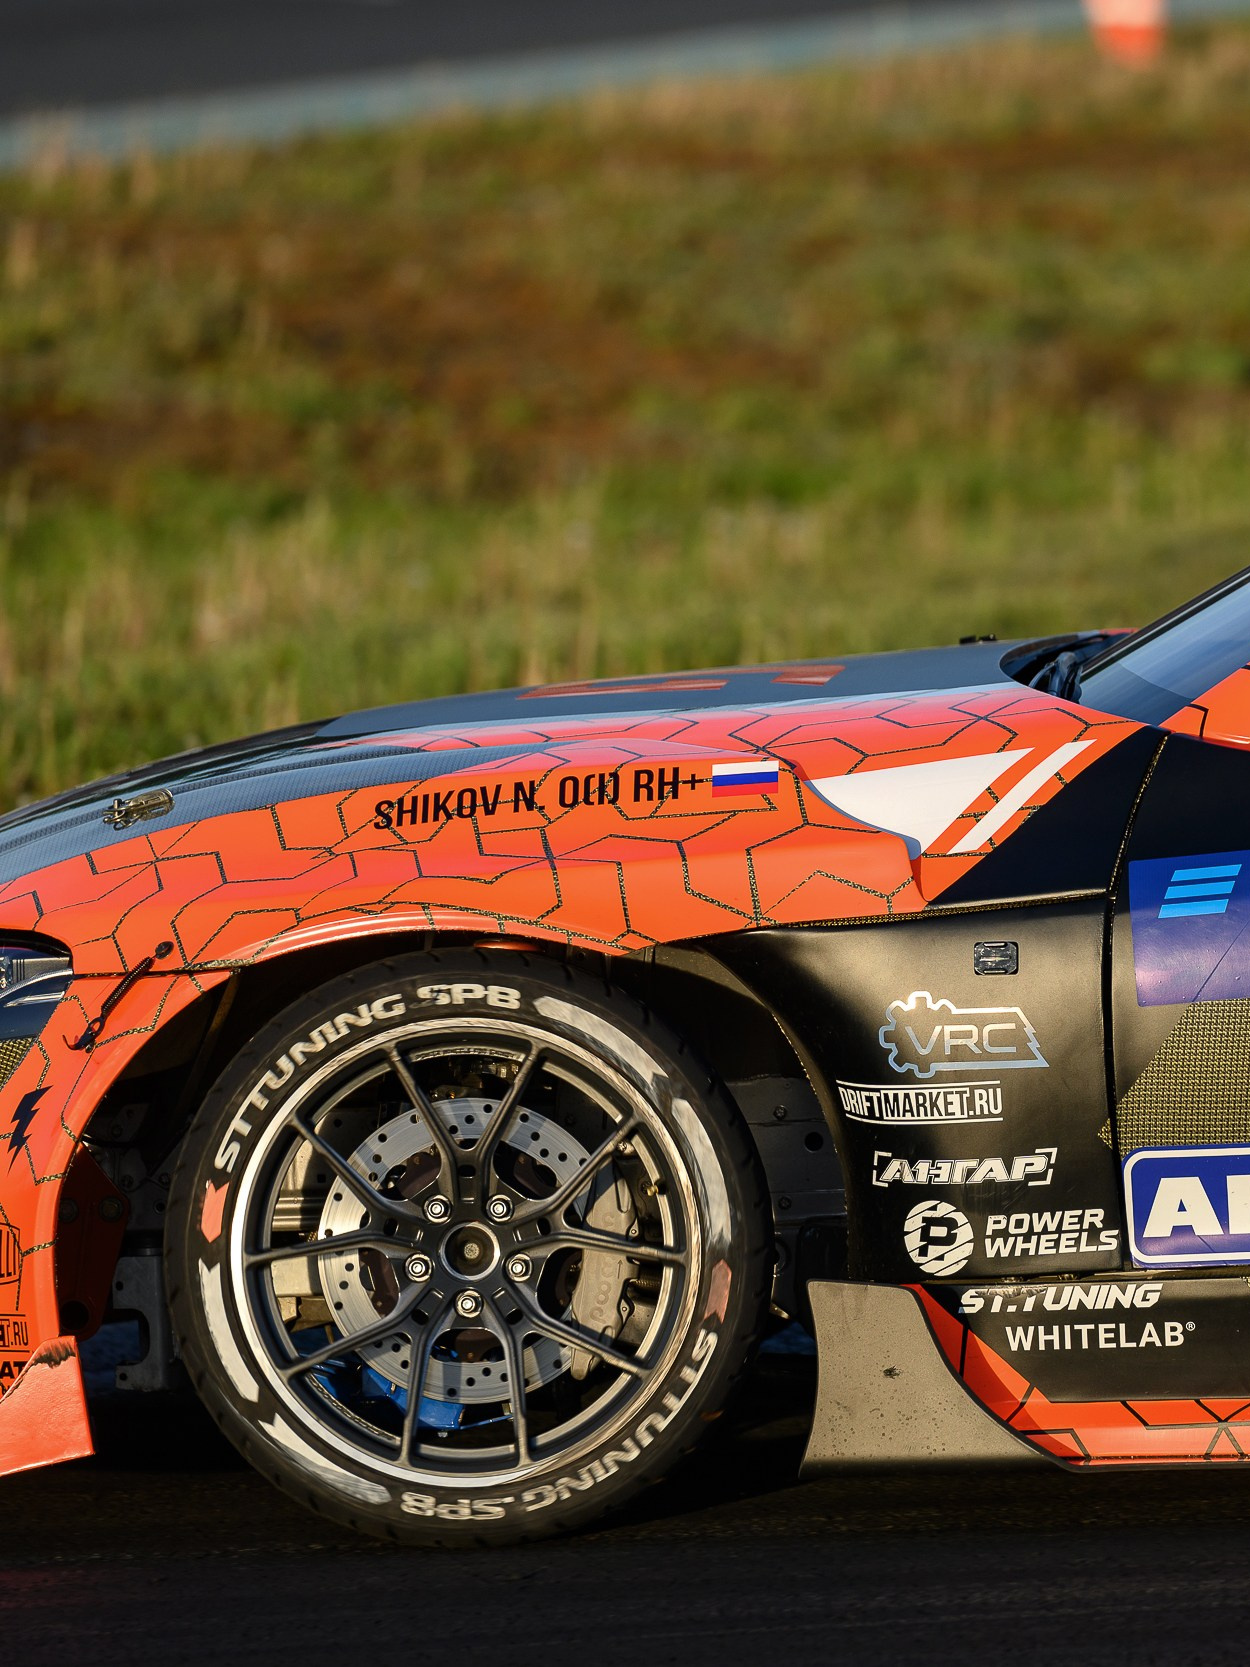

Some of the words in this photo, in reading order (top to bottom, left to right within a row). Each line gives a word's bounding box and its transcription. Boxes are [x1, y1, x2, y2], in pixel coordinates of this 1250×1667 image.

[374, 783, 502, 830] SHIKOV
[513, 779, 546, 813] N.
[633, 767, 703, 803] RH+
[905, 1023, 1017, 1055] VRC
[838, 1086, 1003, 1120] DRIFTMARKET.RU
[986, 1208, 1104, 1236] POWER
[985, 1229, 1120, 1258] WHEELS
